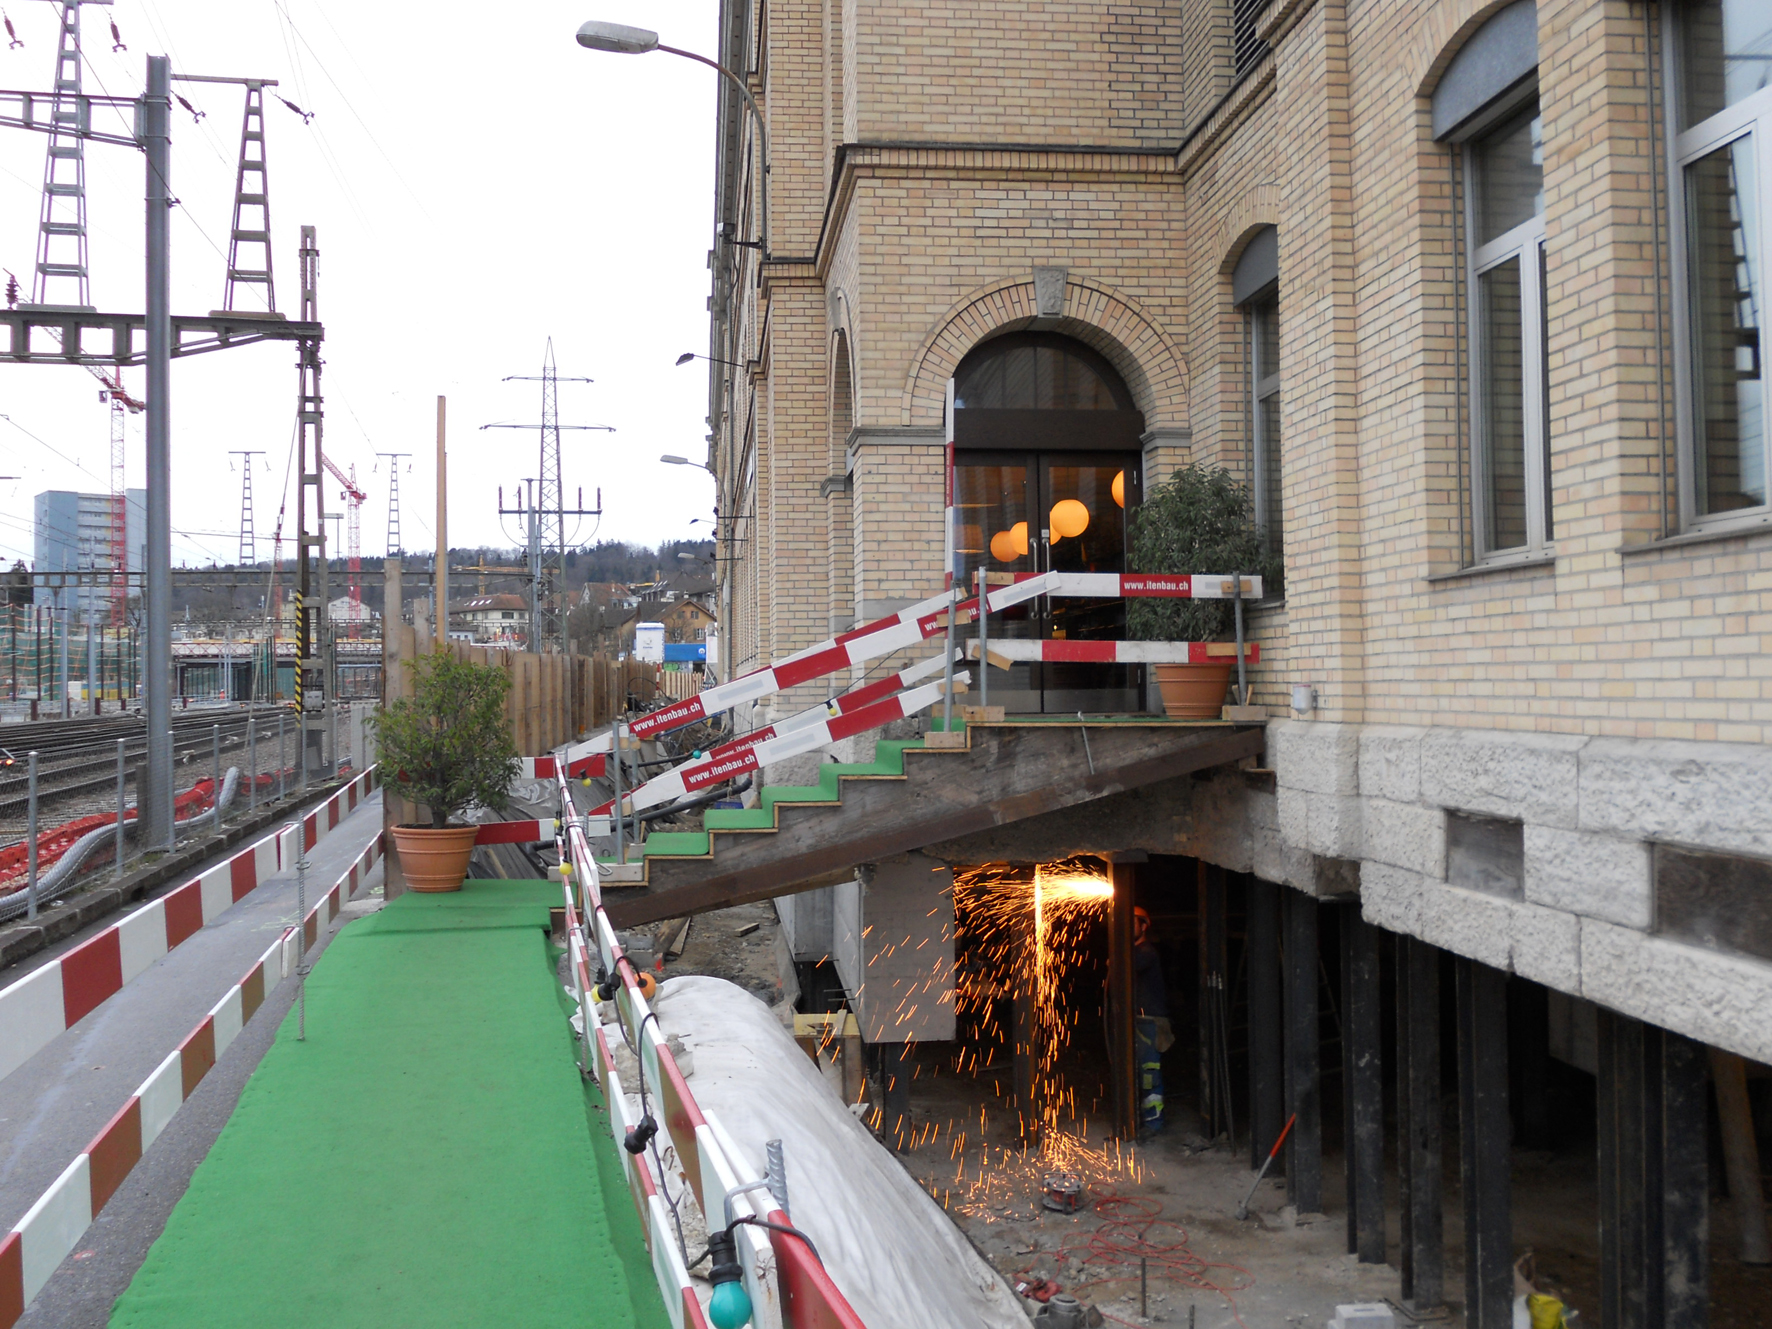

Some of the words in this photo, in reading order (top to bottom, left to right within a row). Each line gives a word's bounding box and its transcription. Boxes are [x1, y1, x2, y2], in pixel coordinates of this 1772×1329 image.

[1124, 580, 1189, 590] www.itenbau.ch
[633, 702, 701, 732] www.itenbau.ch
[715, 732, 775, 760] itenbauch
[688, 754, 756, 783] www.itenbau.ch
